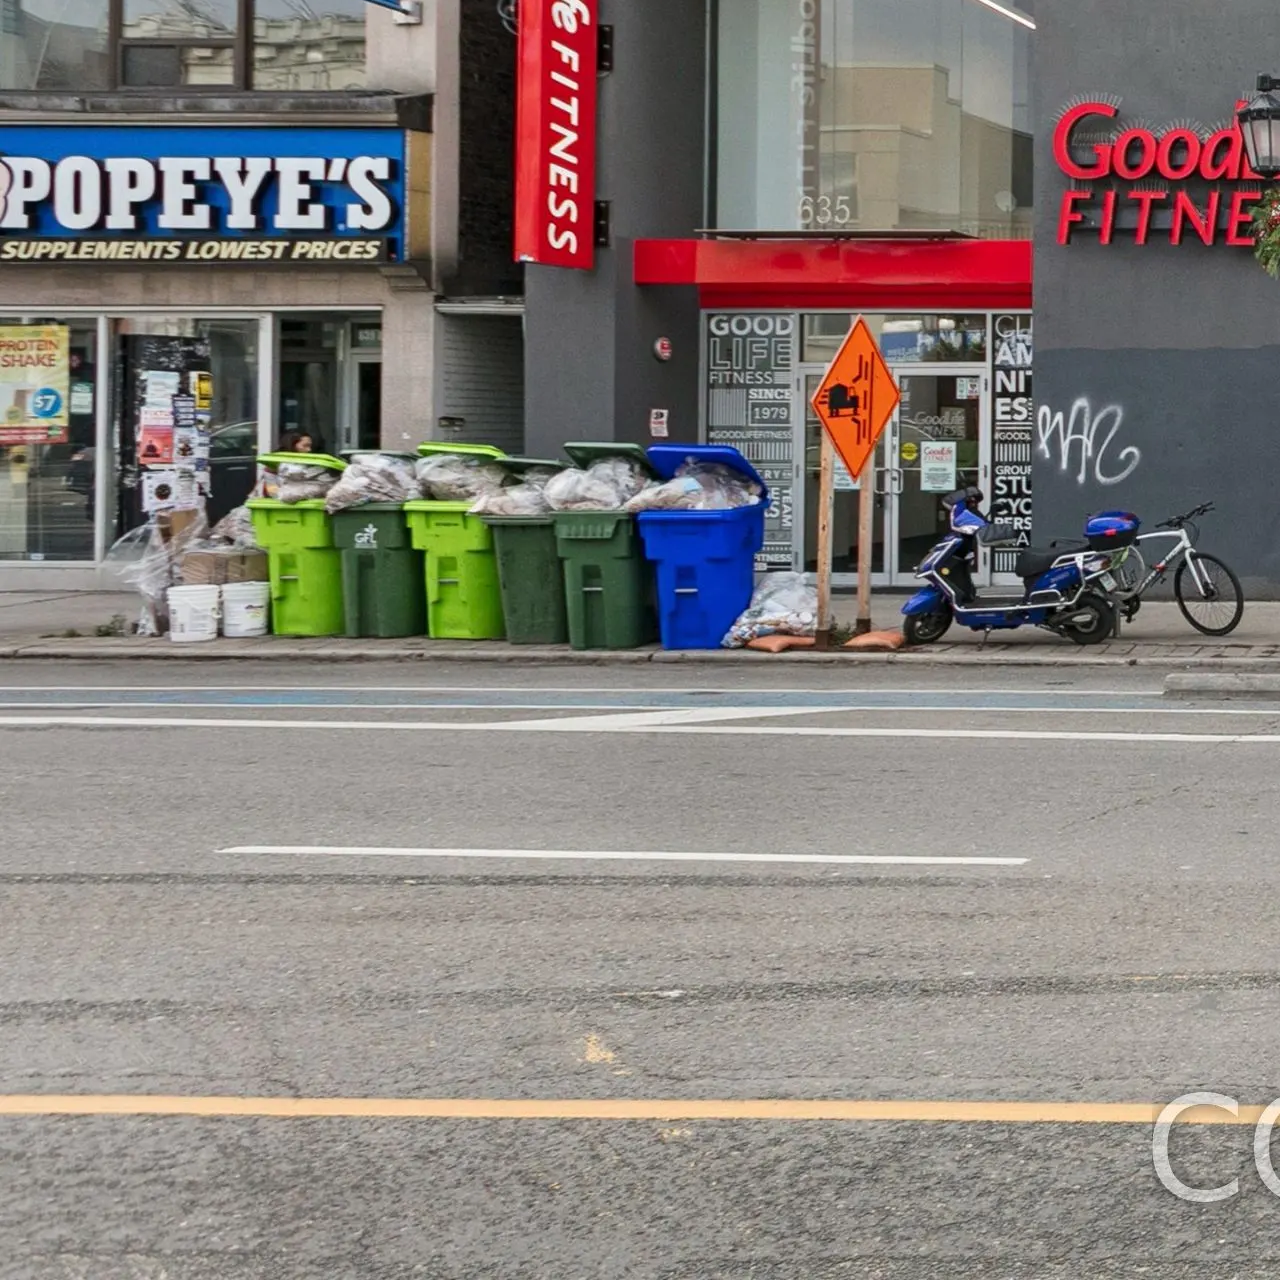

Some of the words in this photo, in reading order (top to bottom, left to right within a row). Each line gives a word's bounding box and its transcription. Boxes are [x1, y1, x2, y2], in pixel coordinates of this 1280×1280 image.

[548, 40, 579, 255] FITNESS
[3, 156, 392, 230] POPEYE'S
[798, 194, 851, 224] 635
[1, 241, 182, 260] SUPPLEMENTS
[186, 241, 290, 260] LOWEST
[291, 241, 381, 260] PRICES
[710, 315, 794, 336] GOOD
[0, 339, 60, 351] PROTEIN
[1, 353, 57, 368] SHAKE
[710, 338, 793, 370] LIFE
[709, 371, 773, 384] FITNESS
[748, 389, 792, 400] SINCE
[35, 395, 57, 411] $7
[753, 407, 788, 420] 1979
[354, 532, 377, 544] GFL
